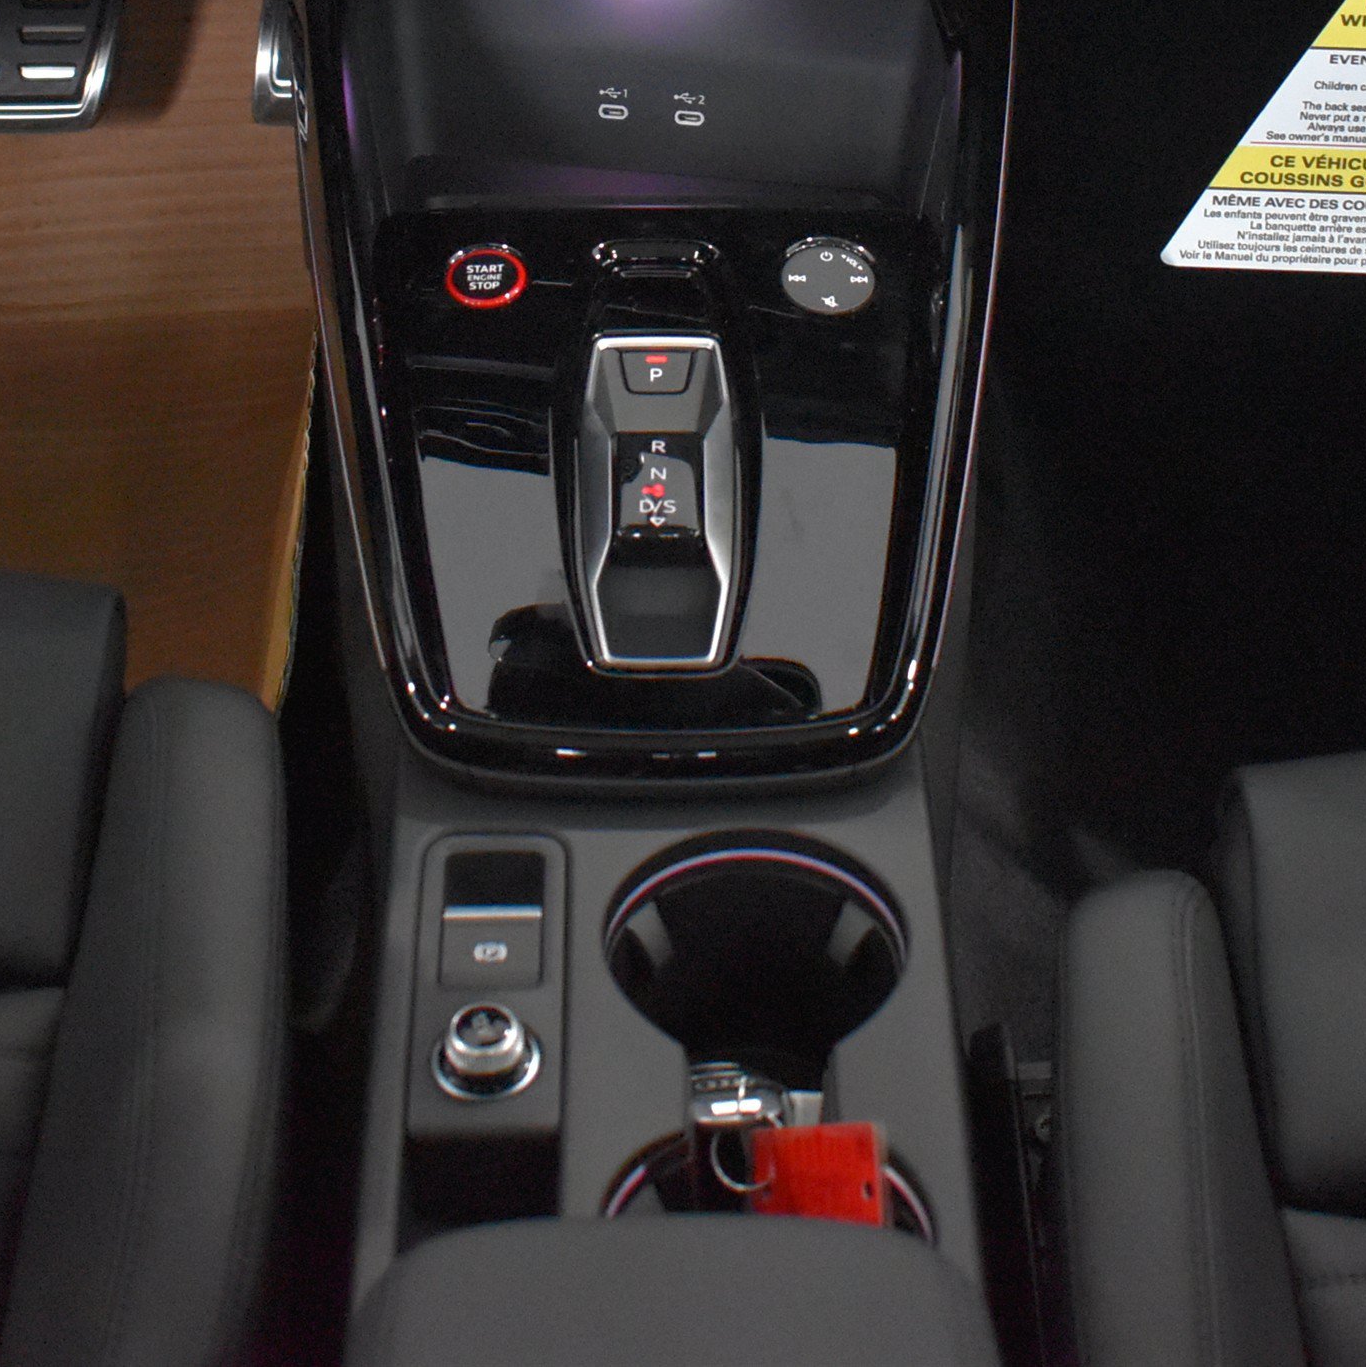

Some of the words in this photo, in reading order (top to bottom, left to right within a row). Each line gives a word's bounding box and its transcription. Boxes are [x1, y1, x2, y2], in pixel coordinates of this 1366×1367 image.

[1314, 81, 1357, 91] Children
[623, 89, 628, 98] 1
[698, 95, 705, 105] 2
[1307, 122, 1345, 133] Always
[1270, 155, 1295, 168] CE
[1240, 171, 1343, 187] COUSSINS
[1212, 194, 1261, 207] MÊME
[1264, 198, 1305, 209] AVEC
[1309, 199, 1338, 210] DES
[466, 263, 504, 275] START
[466, 273, 502, 282] ENGINE
[468, 281, 501, 290] STOP
[650, 368, 663, 382] P
[651, 440, 666, 453] R
[650, 468, 666, 480] N
[639, 500, 677, 514] D/S
